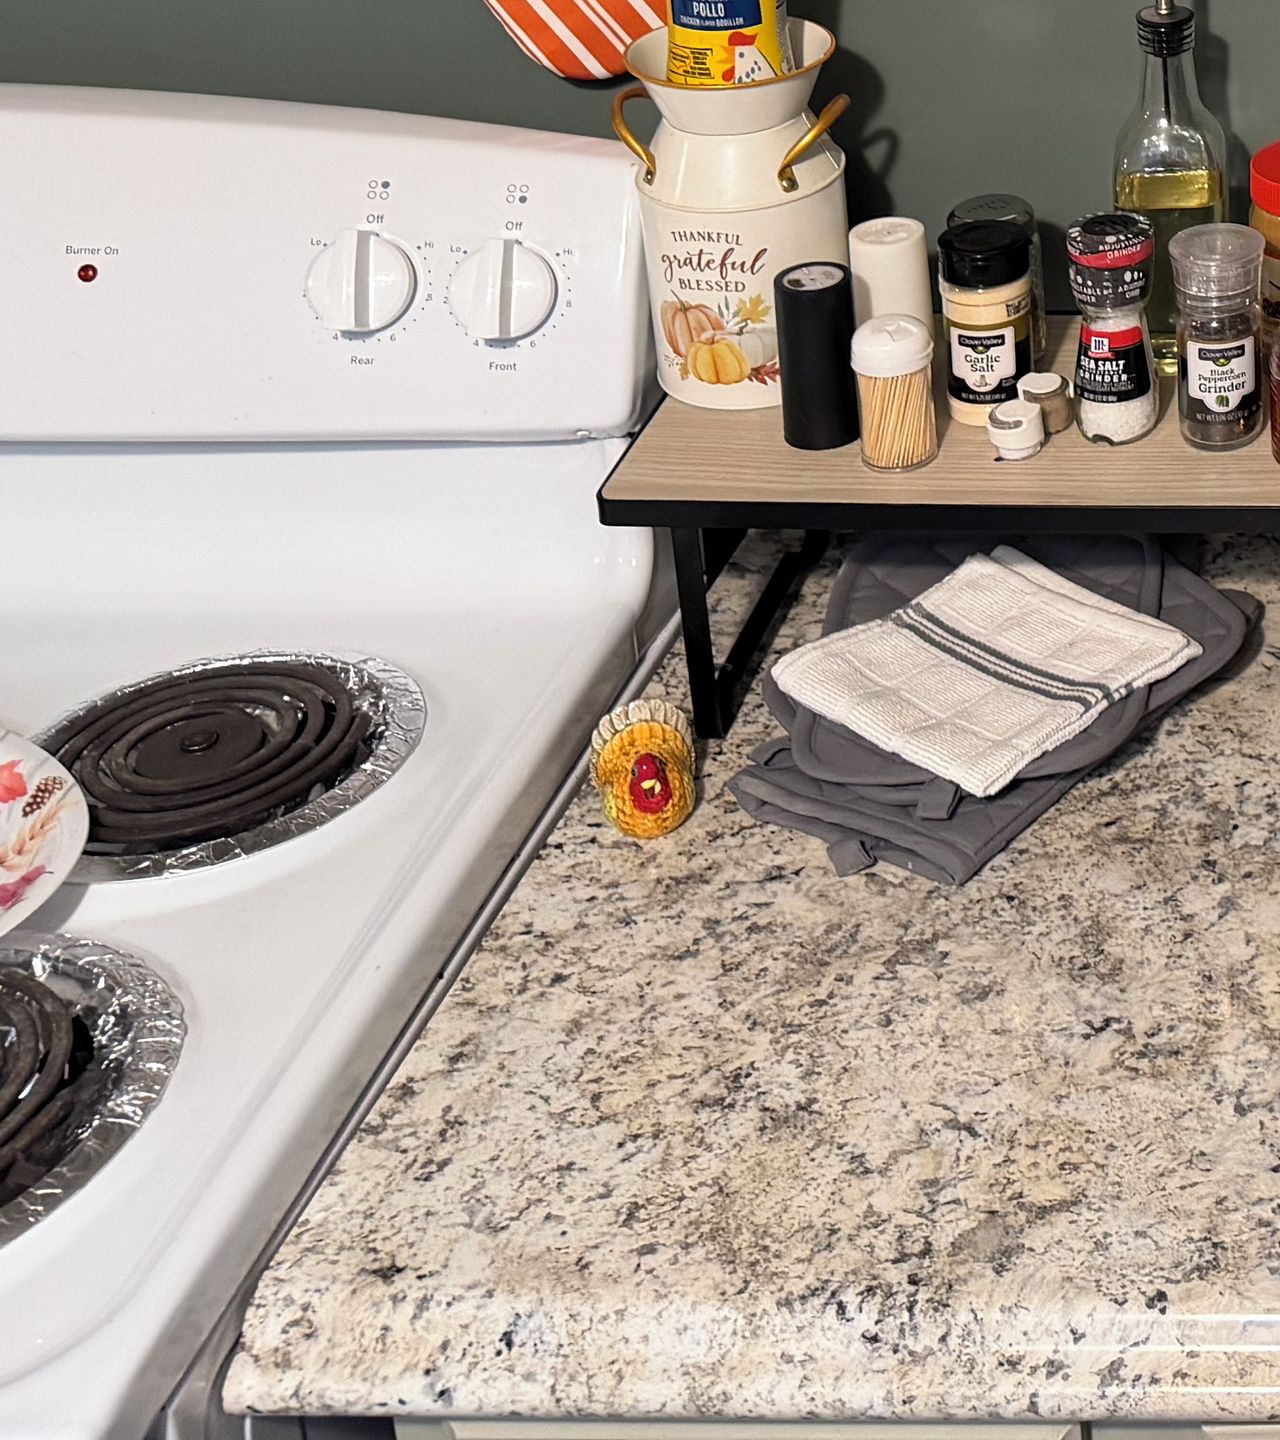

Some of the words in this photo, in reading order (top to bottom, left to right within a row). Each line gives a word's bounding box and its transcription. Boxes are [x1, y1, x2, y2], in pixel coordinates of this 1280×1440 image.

[692, 2, 725, 18] POLLO
[366, 214, 385, 224] Off
[505, 221, 523, 231] Off
[310, 238, 322, 247] Lo
[671, 230, 743, 246] THANKFUL
[424, 240, 434, 250] Hi
[450, 245, 462, 254] Lo
[65, 245, 101, 256] Burner
[104, 246, 119, 256] On
[563, 247, 573, 257] Hi
[661, 247, 768, 283] grateful
[678, 277, 746, 292] BLESSED
[566, 299, 572, 308] 8
[332, 333, 339, 341] 4
[390, 334, 397, 343] 6
[960, 337, 982, 345] Clover
[472, 339, 479, 347] 4
[530, 340, 537, 349] 6
[350, 356, 375, 366] Rear
[964, 354, 1001, 364] Garlic
[1080, 355, 1096, 370] SEA
[1097, 359, 1125, 371] SALT
[488, 362, 517, 372] Front
[970, 363, 995, 373] Salt
[1210, 367, 1235, 377] Black
[1079, 369, 1128, 383] GRINDER
[1198, 371, 1247, 384] Peppercorn
[1198, 380, 1247, 394] Grinder
